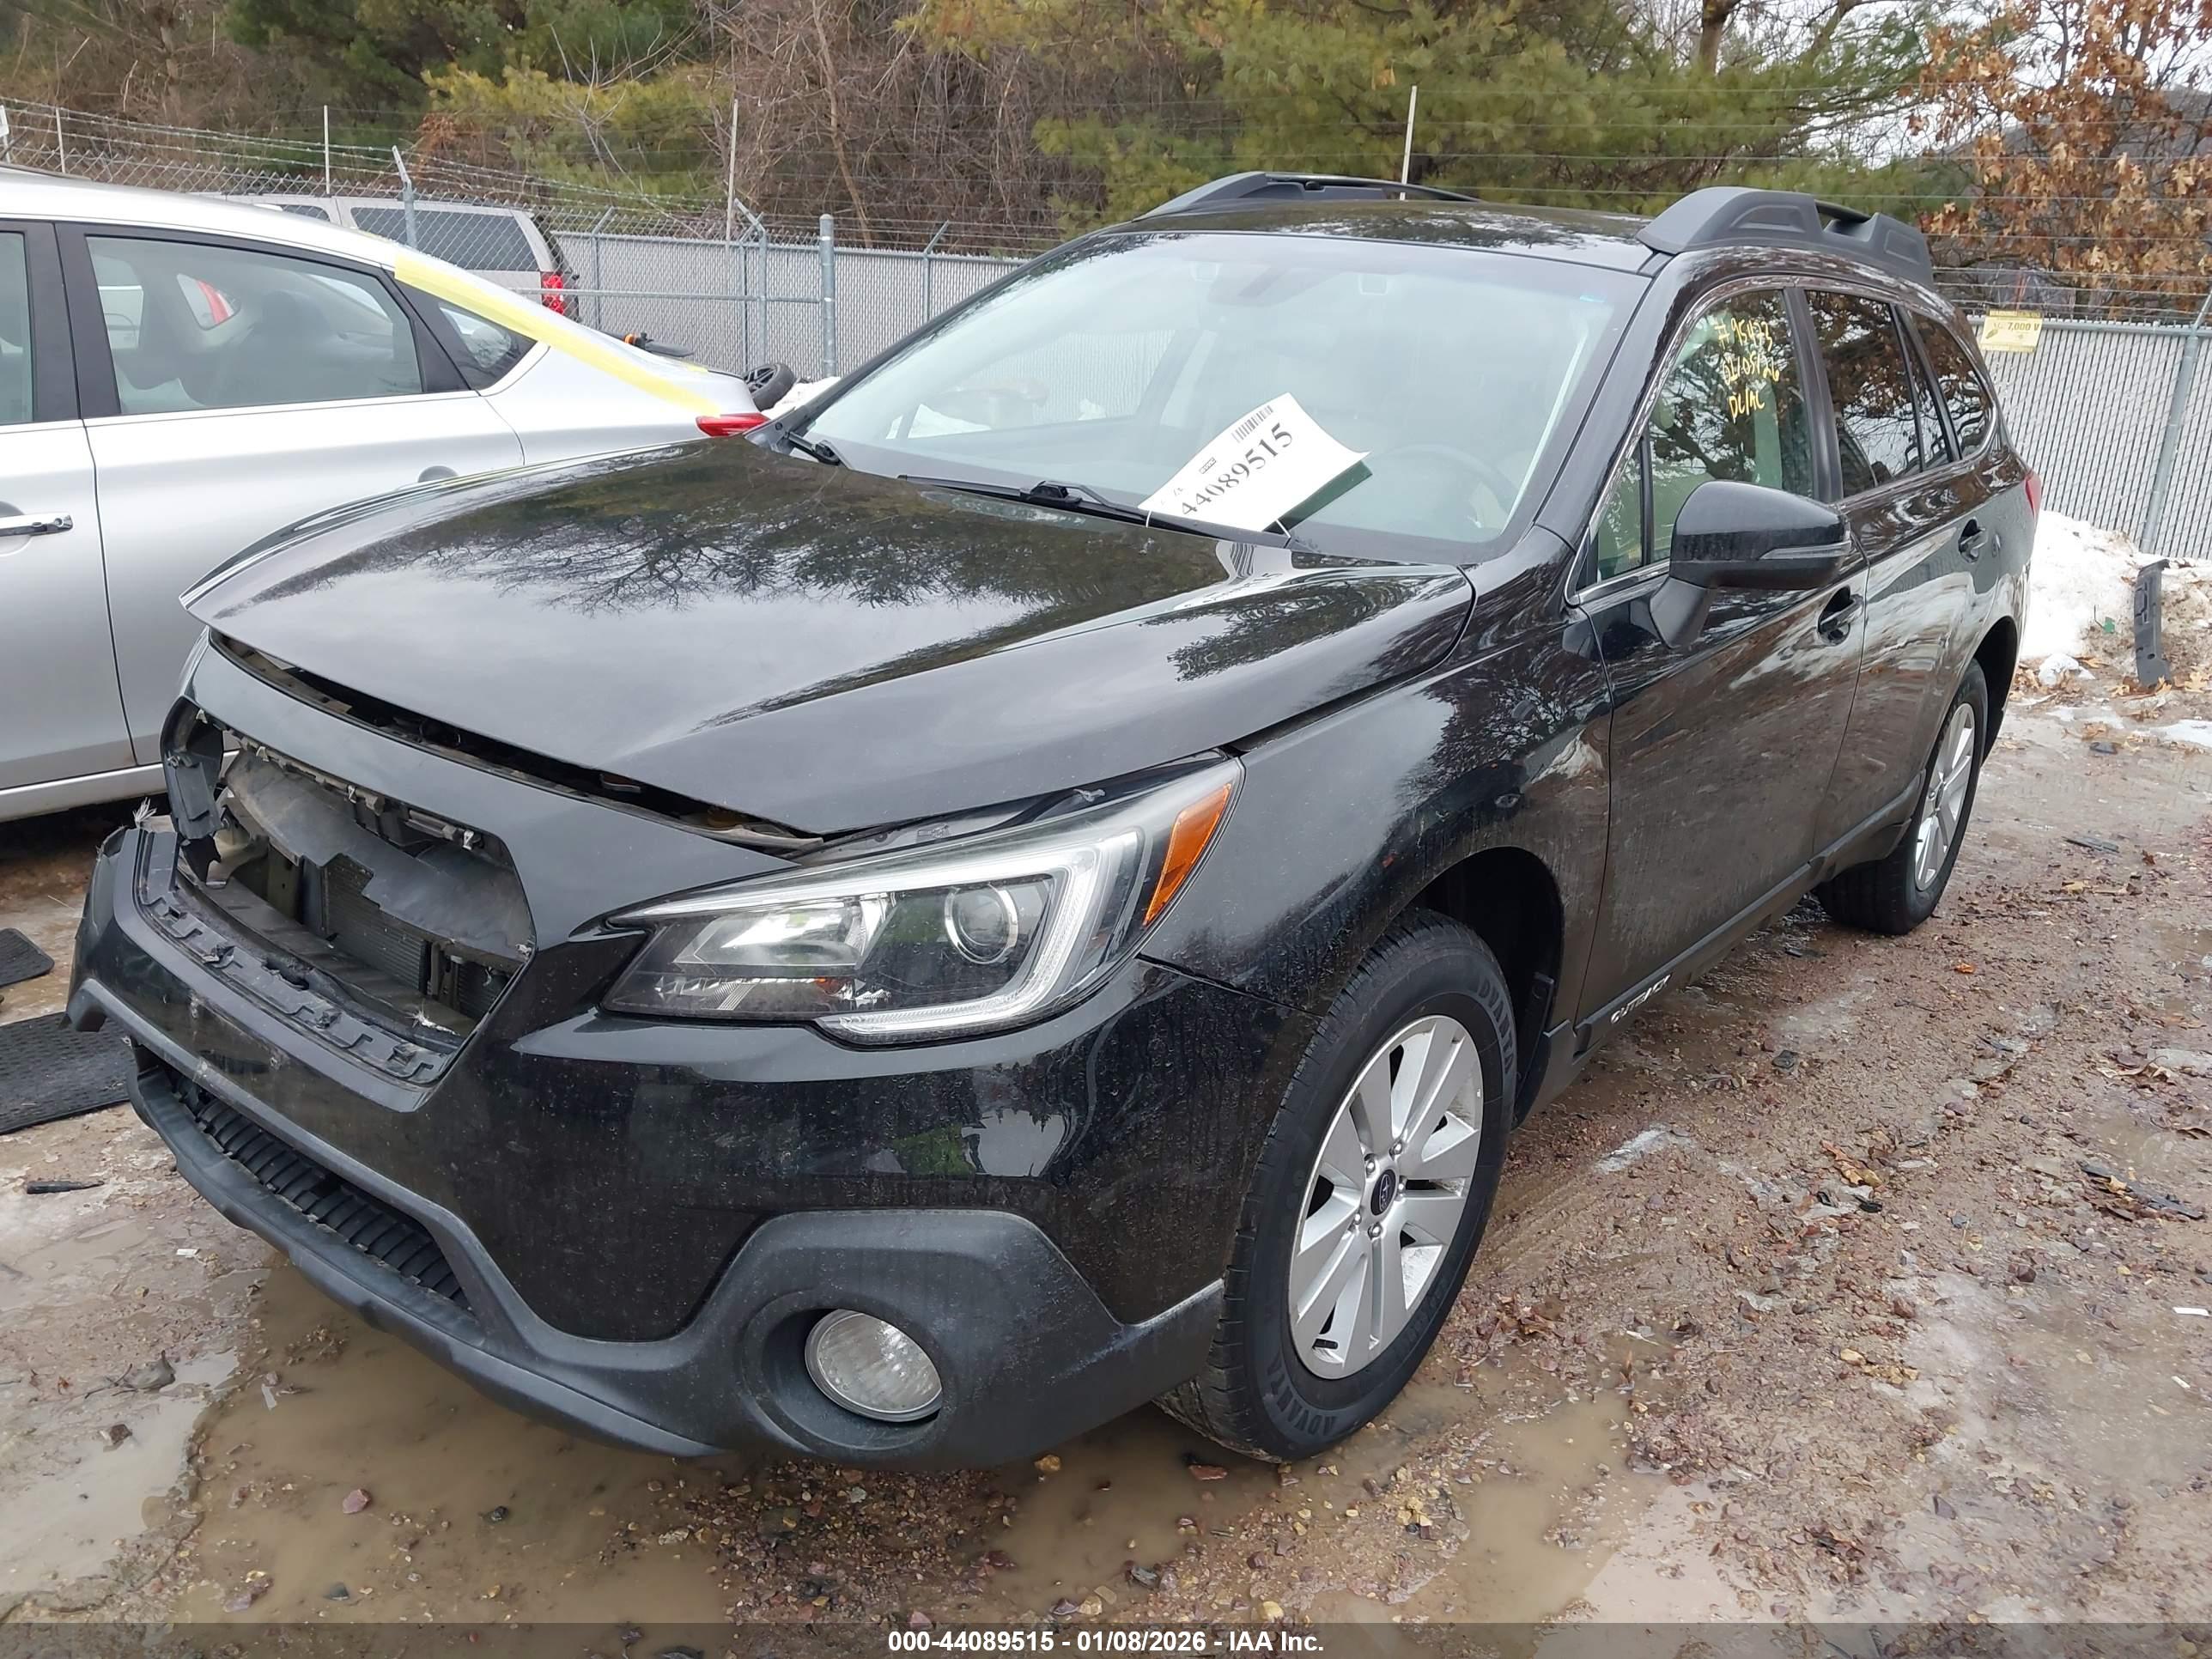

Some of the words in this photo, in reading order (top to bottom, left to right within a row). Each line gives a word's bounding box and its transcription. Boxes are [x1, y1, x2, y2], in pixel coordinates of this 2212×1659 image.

[2007, 322, 2032, 332] 7,000
[2033, 323, 2040, 331] V
[1182, 422, 1293, 515] 44089515
[1266, 1346, 1337, 1437] ADVANTA
